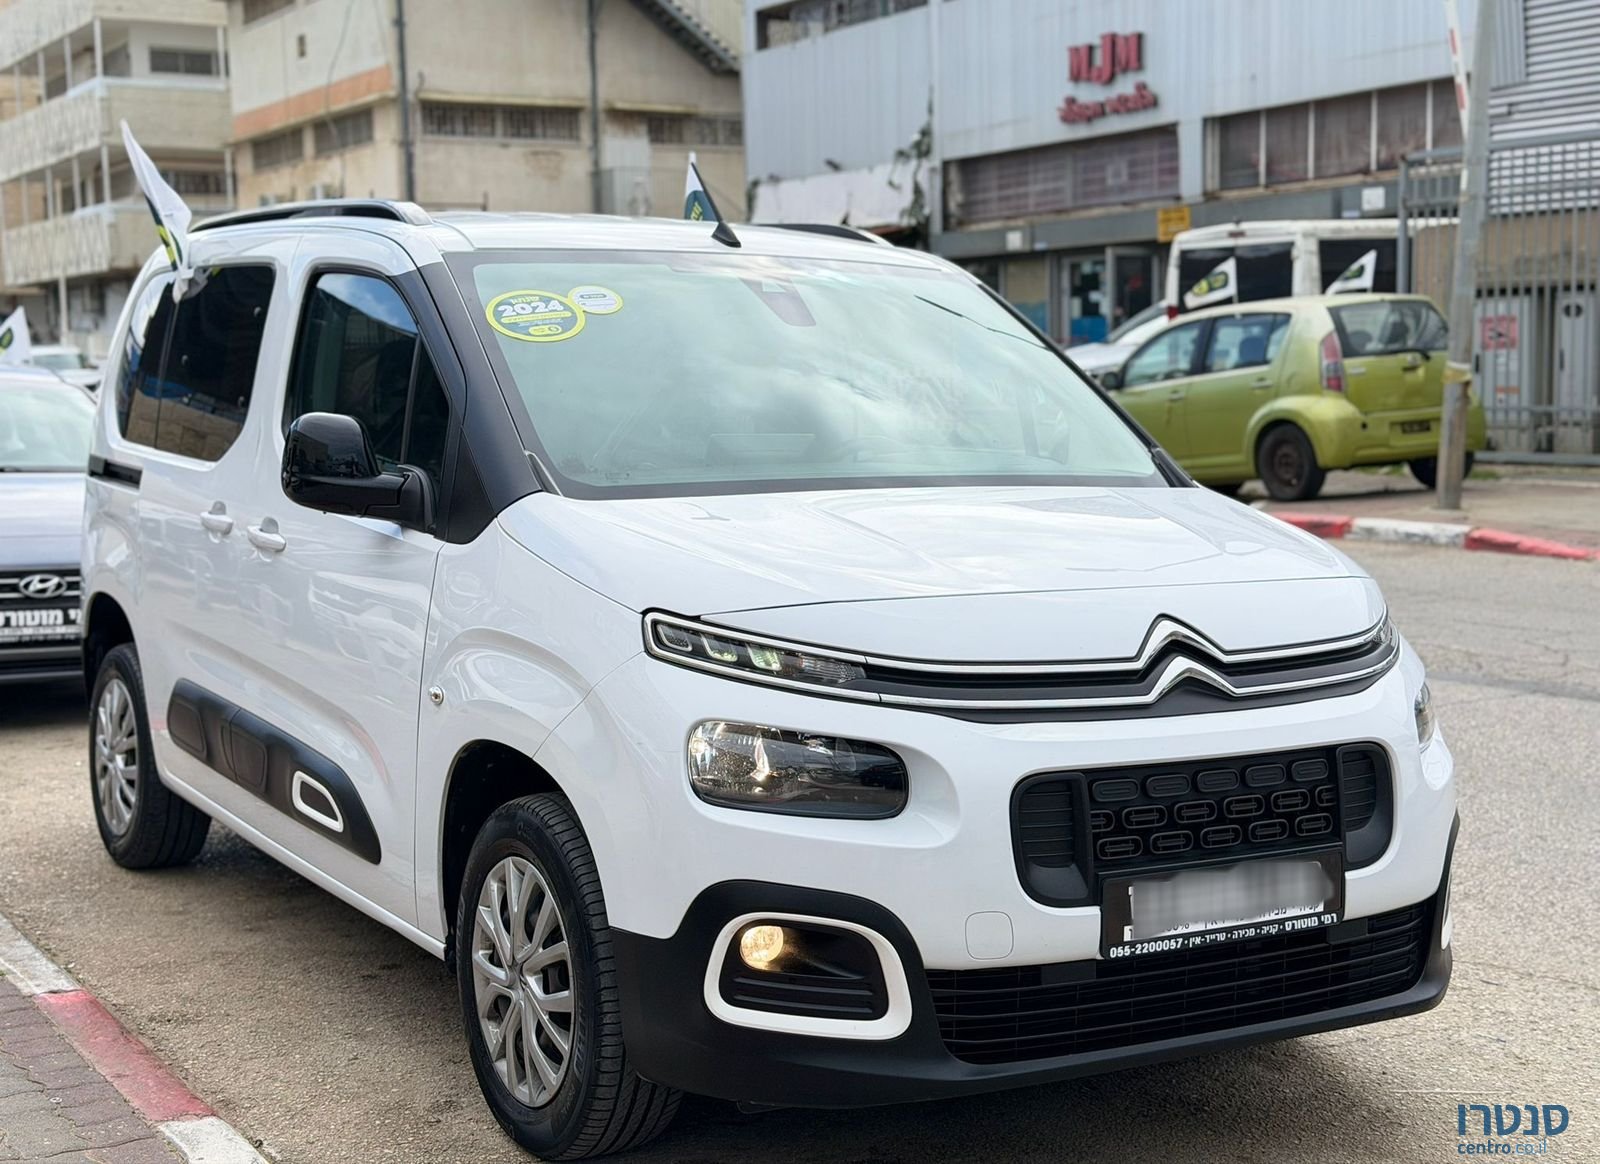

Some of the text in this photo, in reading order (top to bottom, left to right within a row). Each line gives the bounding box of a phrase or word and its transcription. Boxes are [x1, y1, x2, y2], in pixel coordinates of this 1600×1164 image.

[1067, 33, 1142, 85] MJM
[497, 300, 564, 317] 2024
[1285, 916, 1319, 931] מוטורס
[1321, 913, 1337, 925] רמי
[1232, 928, 1256, 940] מכירה
[1261, 924, 1279, 935] קניה
[1189, 932, 1226, 948] טרייד-אין
[1109, 938, 1184, 959] 055-2200057
